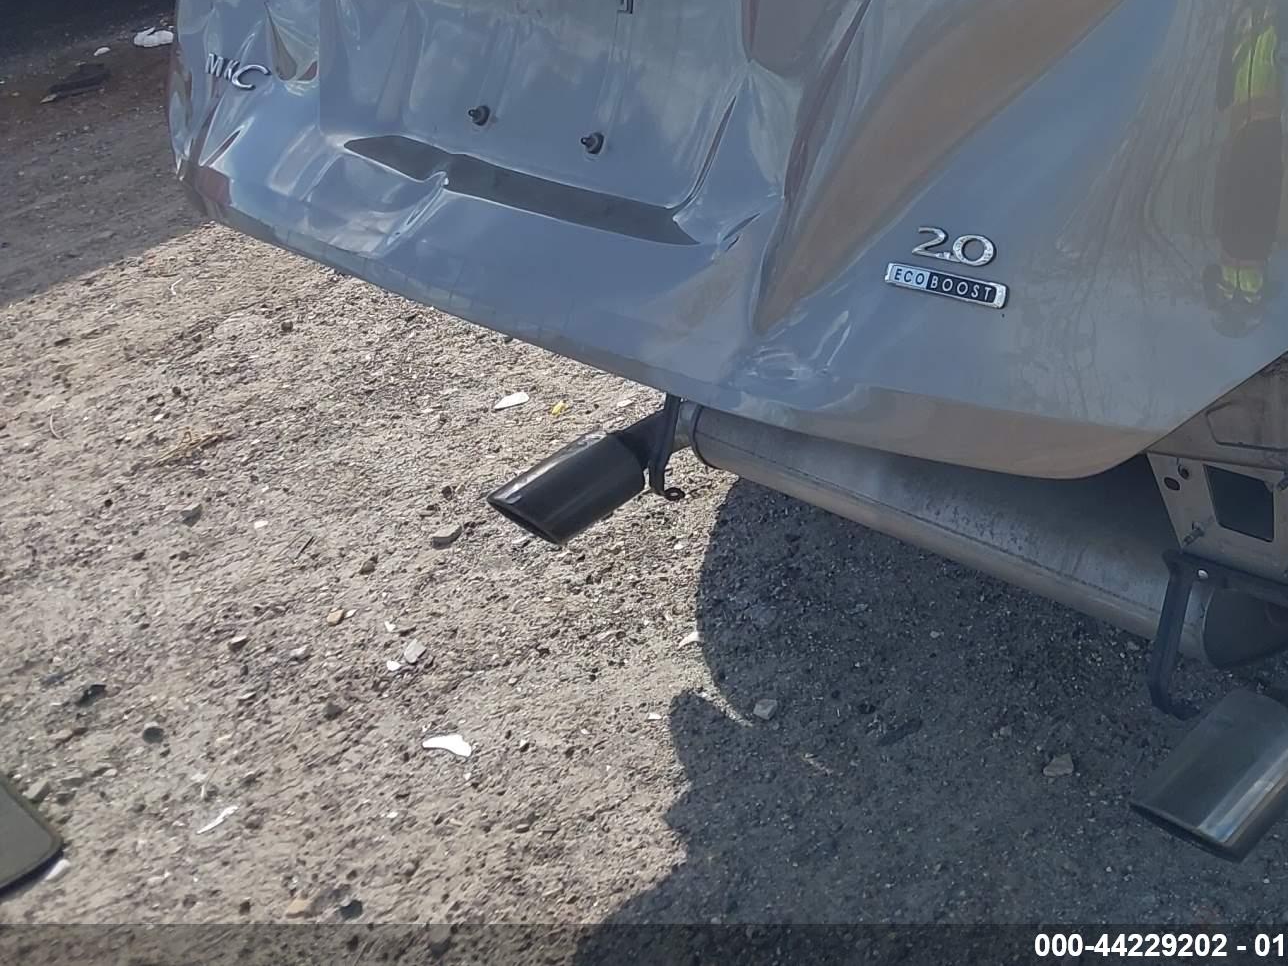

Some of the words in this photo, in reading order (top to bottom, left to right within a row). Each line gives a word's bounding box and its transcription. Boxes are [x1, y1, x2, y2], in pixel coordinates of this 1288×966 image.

[205, 52, 272, 91] MKC
[911, 225, 997, 267] 2.0
[893, 267, 993, 301] ECOBOOST
